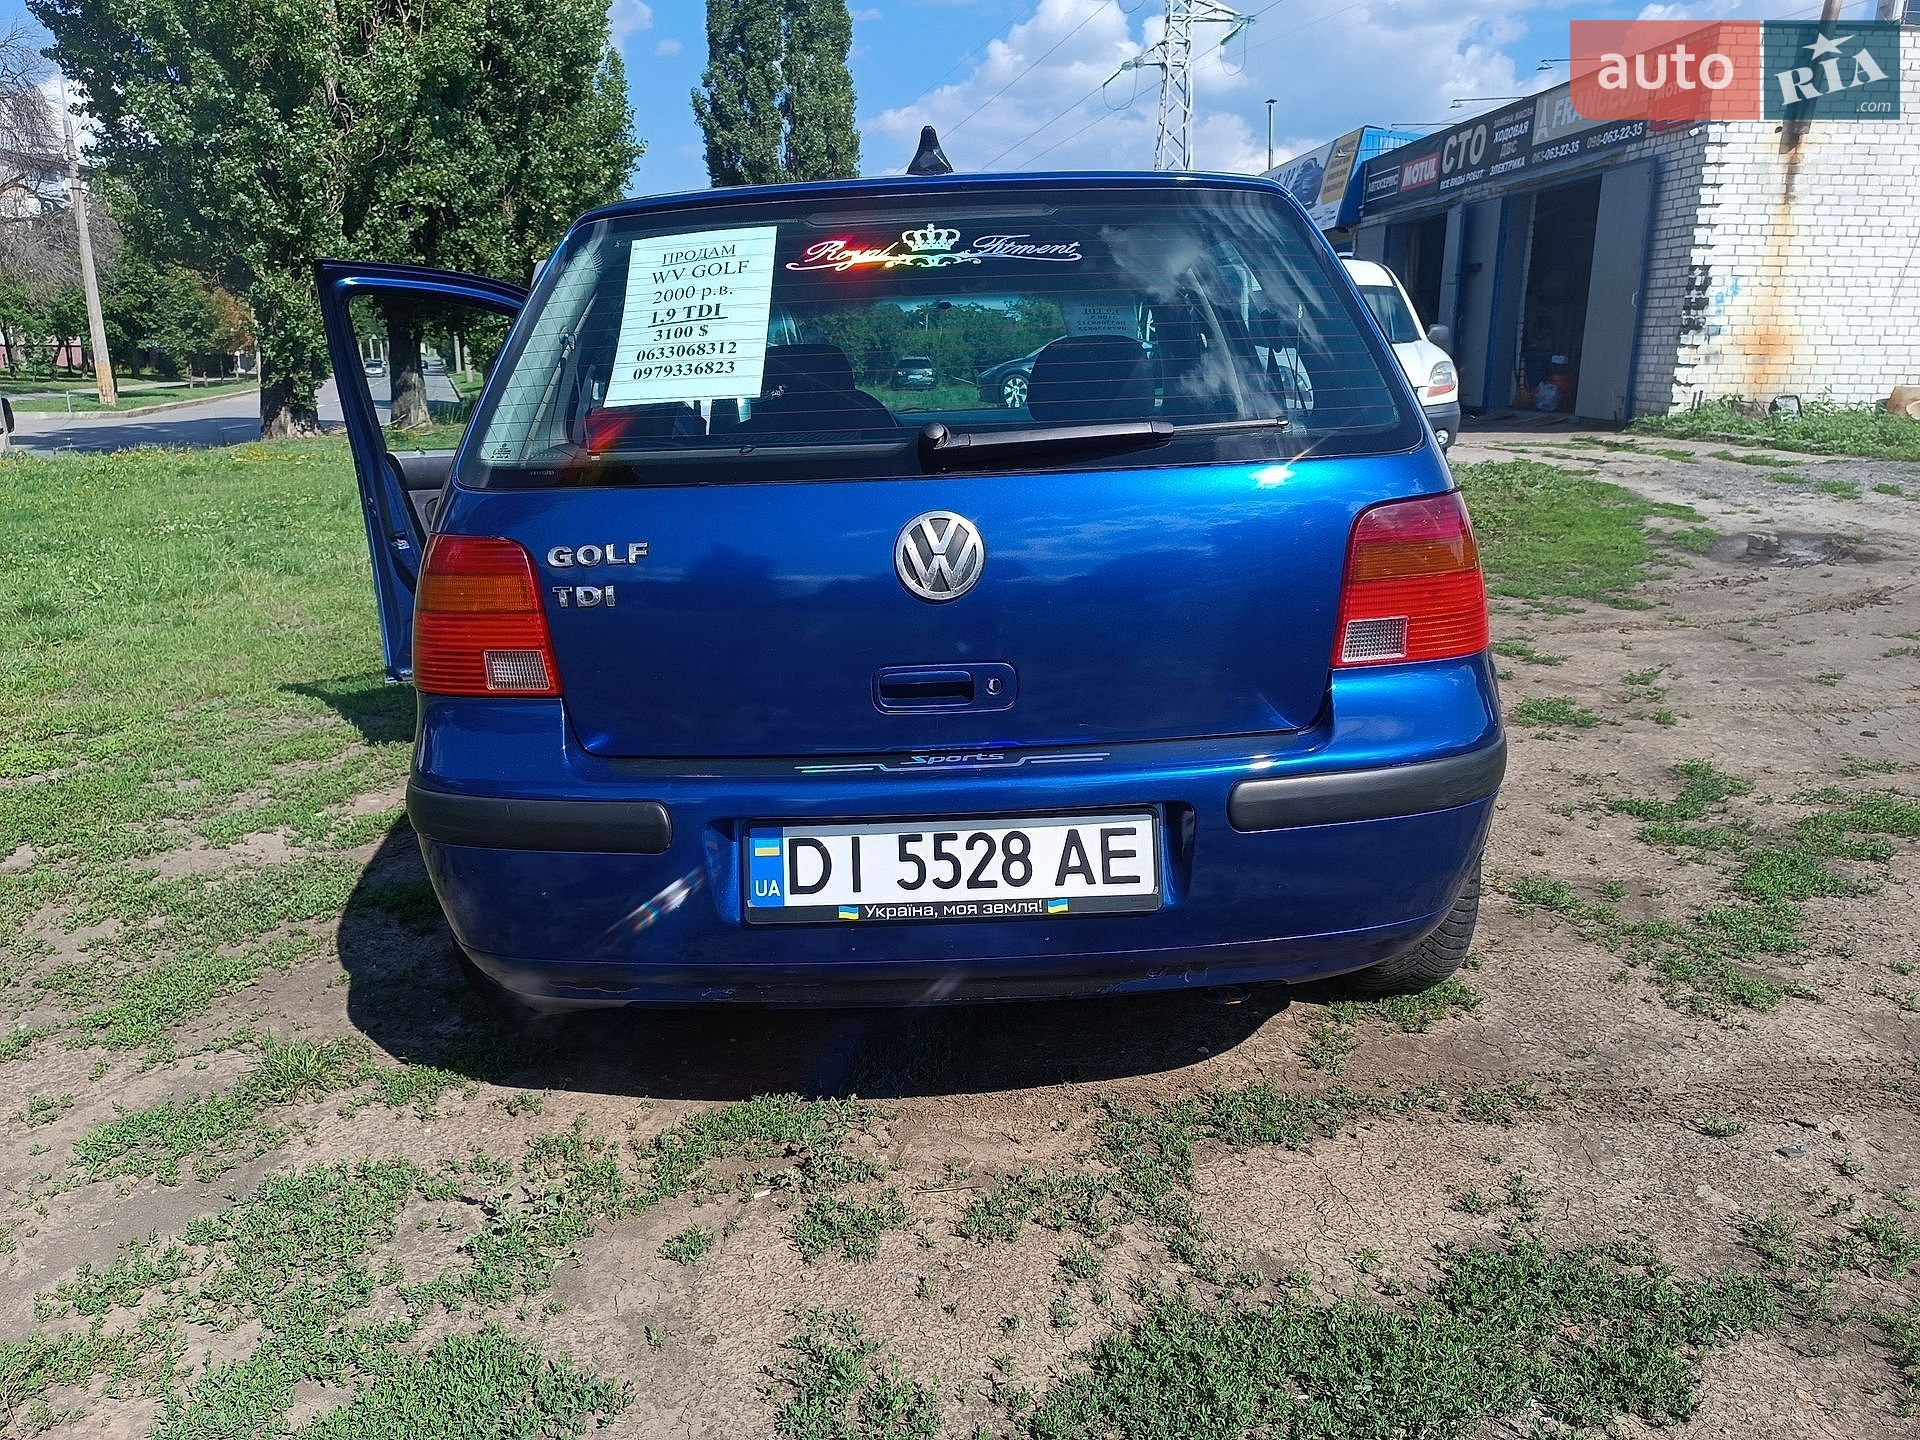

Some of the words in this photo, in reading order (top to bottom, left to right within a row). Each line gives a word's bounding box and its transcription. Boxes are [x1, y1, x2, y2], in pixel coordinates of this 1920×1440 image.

[1493, 121, 1529, 143] ХОДОВАЯ
[1442, 124, 1487, 174] СТО
[1500, 140, 1518, 159] ДВС
[1402, 158, 1437, 187] MOTUL
[662, 244, 736, 265] ПРОДАМ
[790, 240, 900, 271] Royal
[973, 234, 1081, 261] Fitment
[652, 268, 685, 284] WV
[692, 260, 749, 278] GOLF
[652, 286, 695, 304] 2000
[683, 303, 722, 319] TDI
[653, 325, 693, 341] 3100
[699, 324, 709, 337] $
[636, 342, 737, 361] 0633068312
[633, 361, 735, 380] 0979336823
[547, 542, 648, 567] GOLF
[552, 585, 616, 607] TDI
[906, 752, 1004, 765] Sports
[788, 836, 862, 895] DI
[897, 830, 1032, 890] 5528
[1055, 827, 1141, 886] AE
[755, 879, 780, 897] UA
[865, 903, 938, 920] Україна,
[943, 904, 978, 916] моя
[983, 900, 1043, 916] земля!
